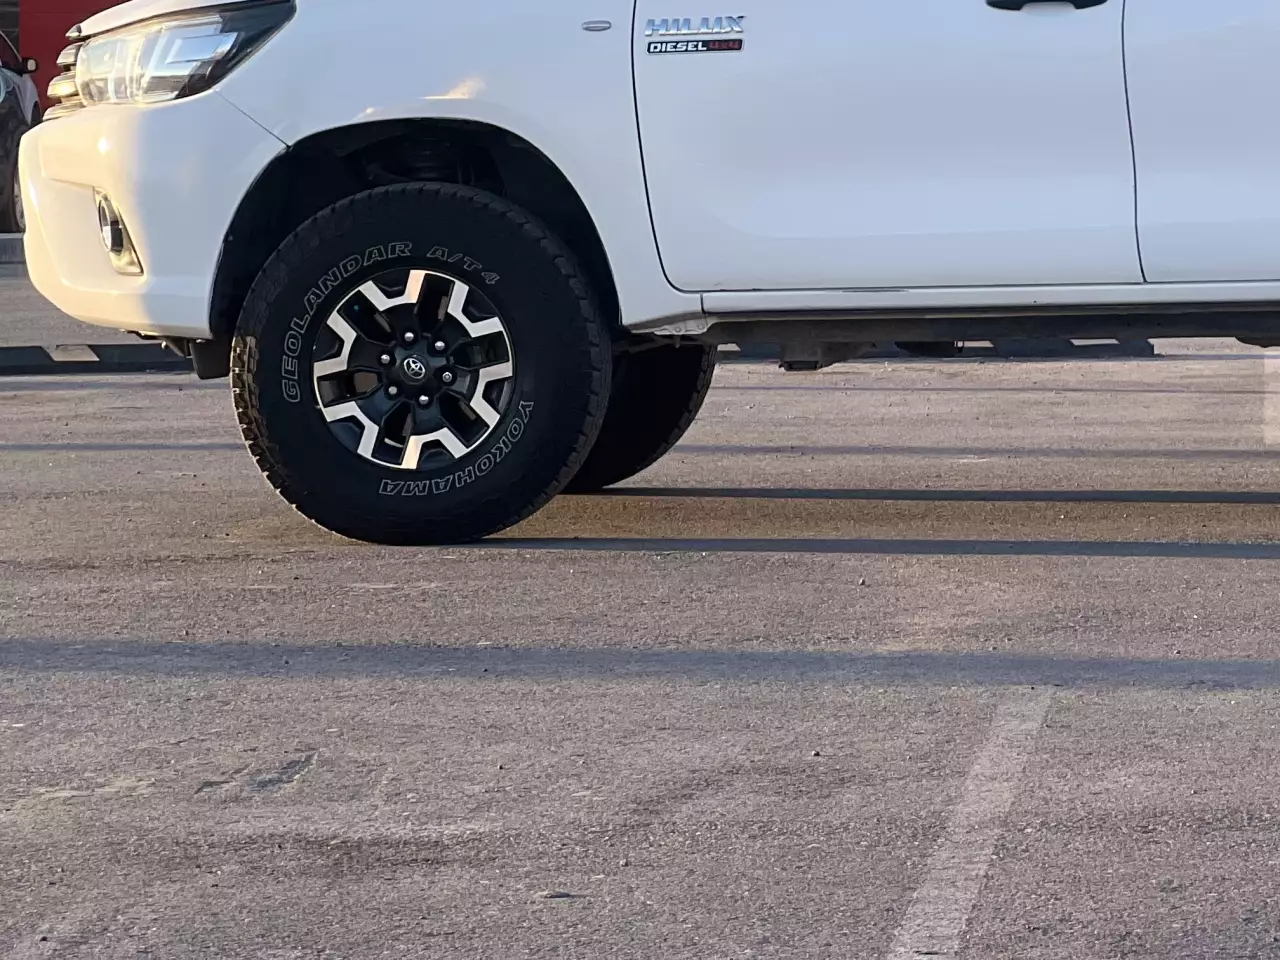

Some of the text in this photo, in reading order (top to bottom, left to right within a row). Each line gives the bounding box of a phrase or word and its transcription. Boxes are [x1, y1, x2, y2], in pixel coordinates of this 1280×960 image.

[644, 15, 747, 37] HILUX
[649, 41, 707, 53] DIESEL
[281, 241, 412, 403] GEOLANDAR
[378, 400, 535, 497] YOKOHAMA
